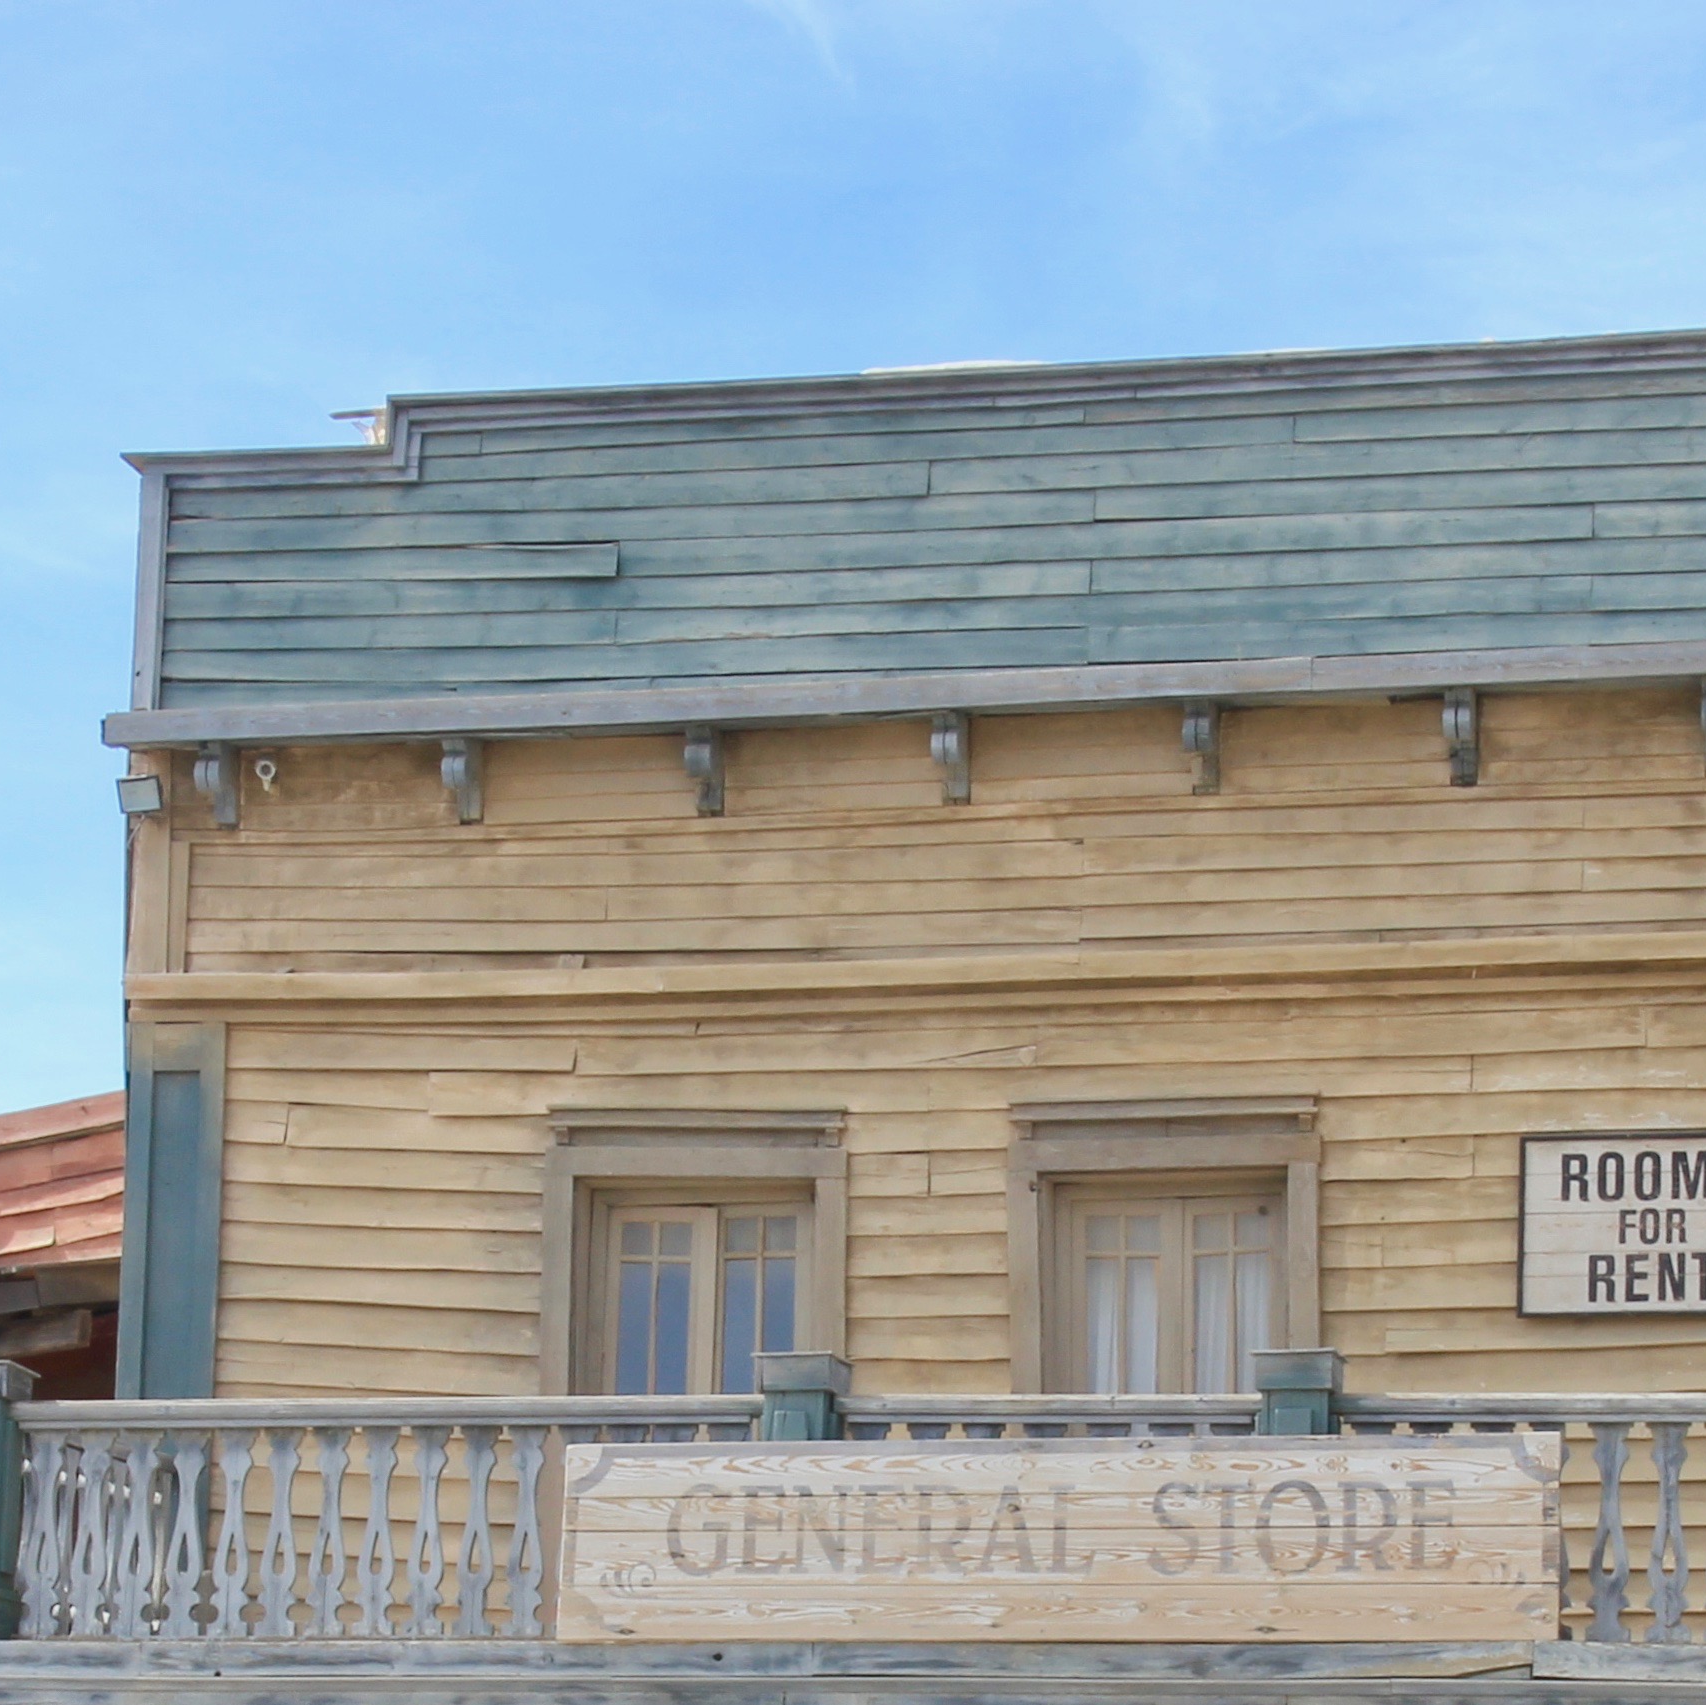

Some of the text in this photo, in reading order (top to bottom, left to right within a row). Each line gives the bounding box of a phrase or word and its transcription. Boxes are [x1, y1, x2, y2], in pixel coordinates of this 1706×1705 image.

[1618, 1207, 1688, 1245] FOR
[666, 1479, 1458, 1577] GENERAL STORE
